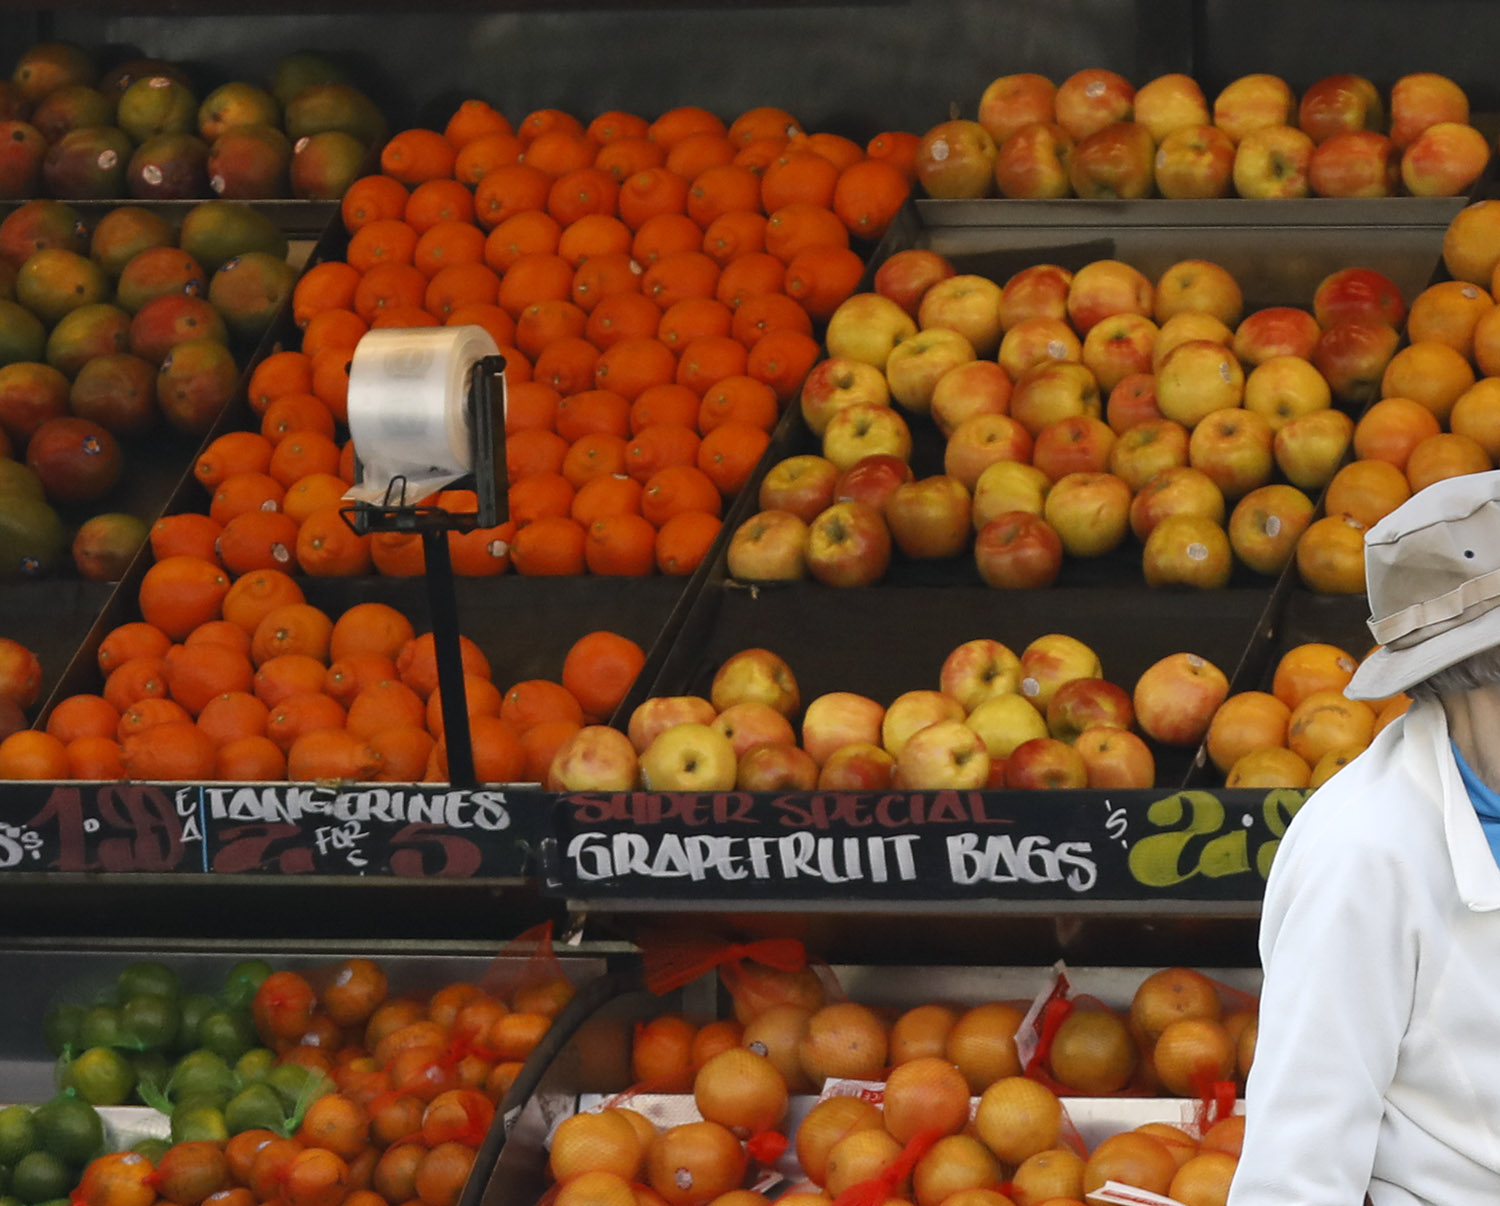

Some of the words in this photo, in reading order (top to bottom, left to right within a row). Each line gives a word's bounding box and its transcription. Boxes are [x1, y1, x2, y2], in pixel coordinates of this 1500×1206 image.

[205, 788, 511, 831] TANGERINES
[567, 791, 759, 826] SUPER
[772, 789, 1014, 829] SPECIAL
[315, 820, 369, 855] FOR
[567, 831, 921, 883] GRAPEFRUIT
[946, 832, 1097, 892] BAGS
